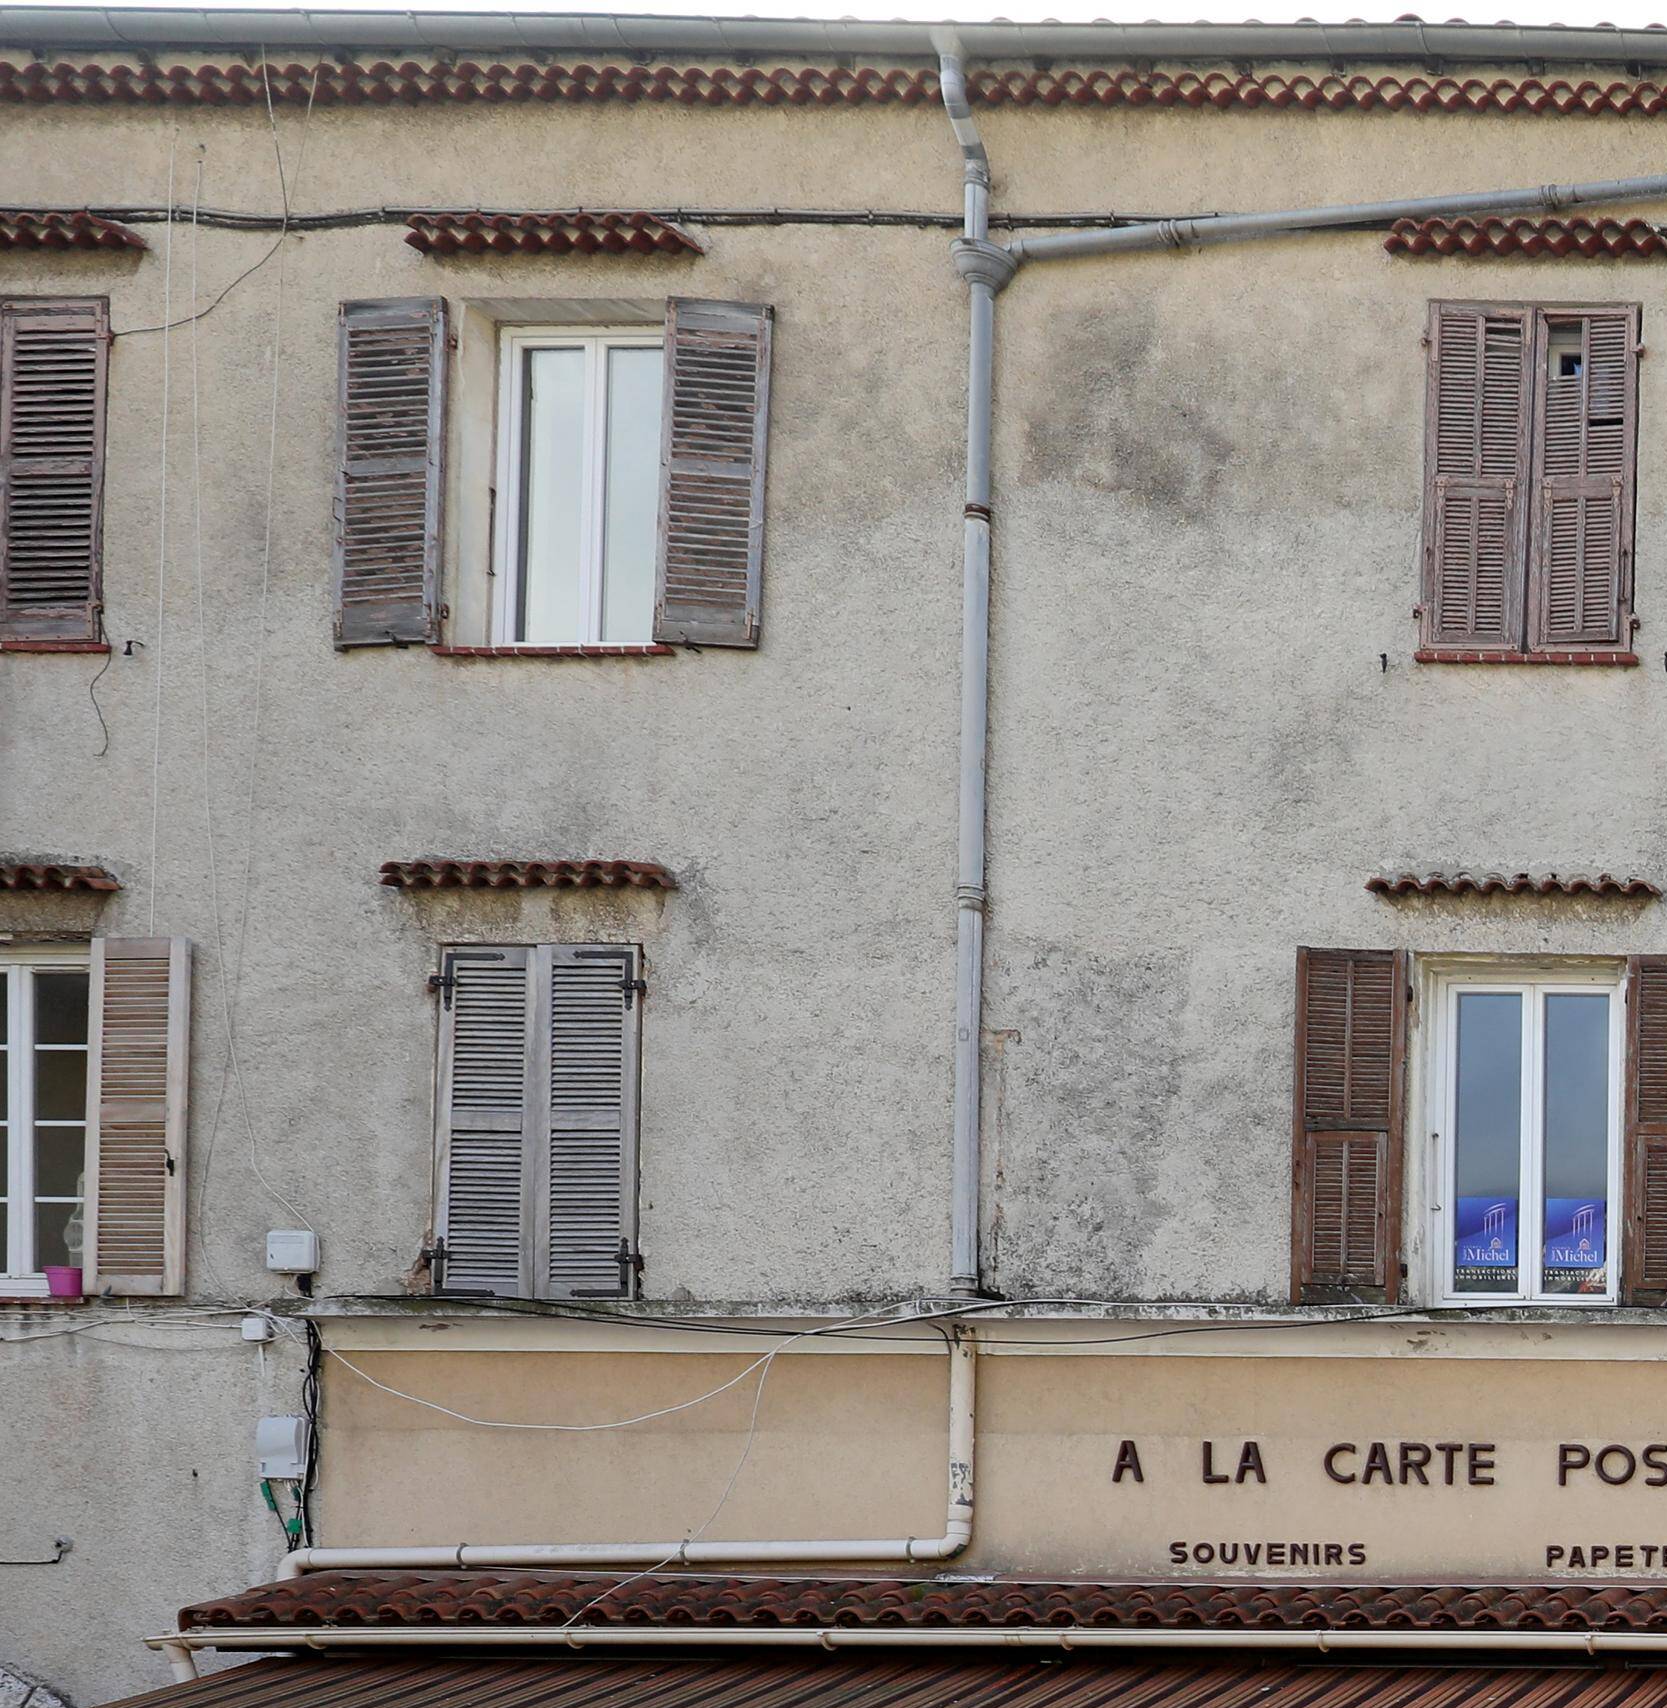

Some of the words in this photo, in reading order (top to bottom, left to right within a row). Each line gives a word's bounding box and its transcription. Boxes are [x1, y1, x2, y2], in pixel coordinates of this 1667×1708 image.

[1112, 1440, 1144, 1483] A
[1202, 1441, 1266, 1484] LA
[1324, 1441, 1496, 1486] CARTE
[1169, 1541, 1366, 1566] SOUVENIRS
